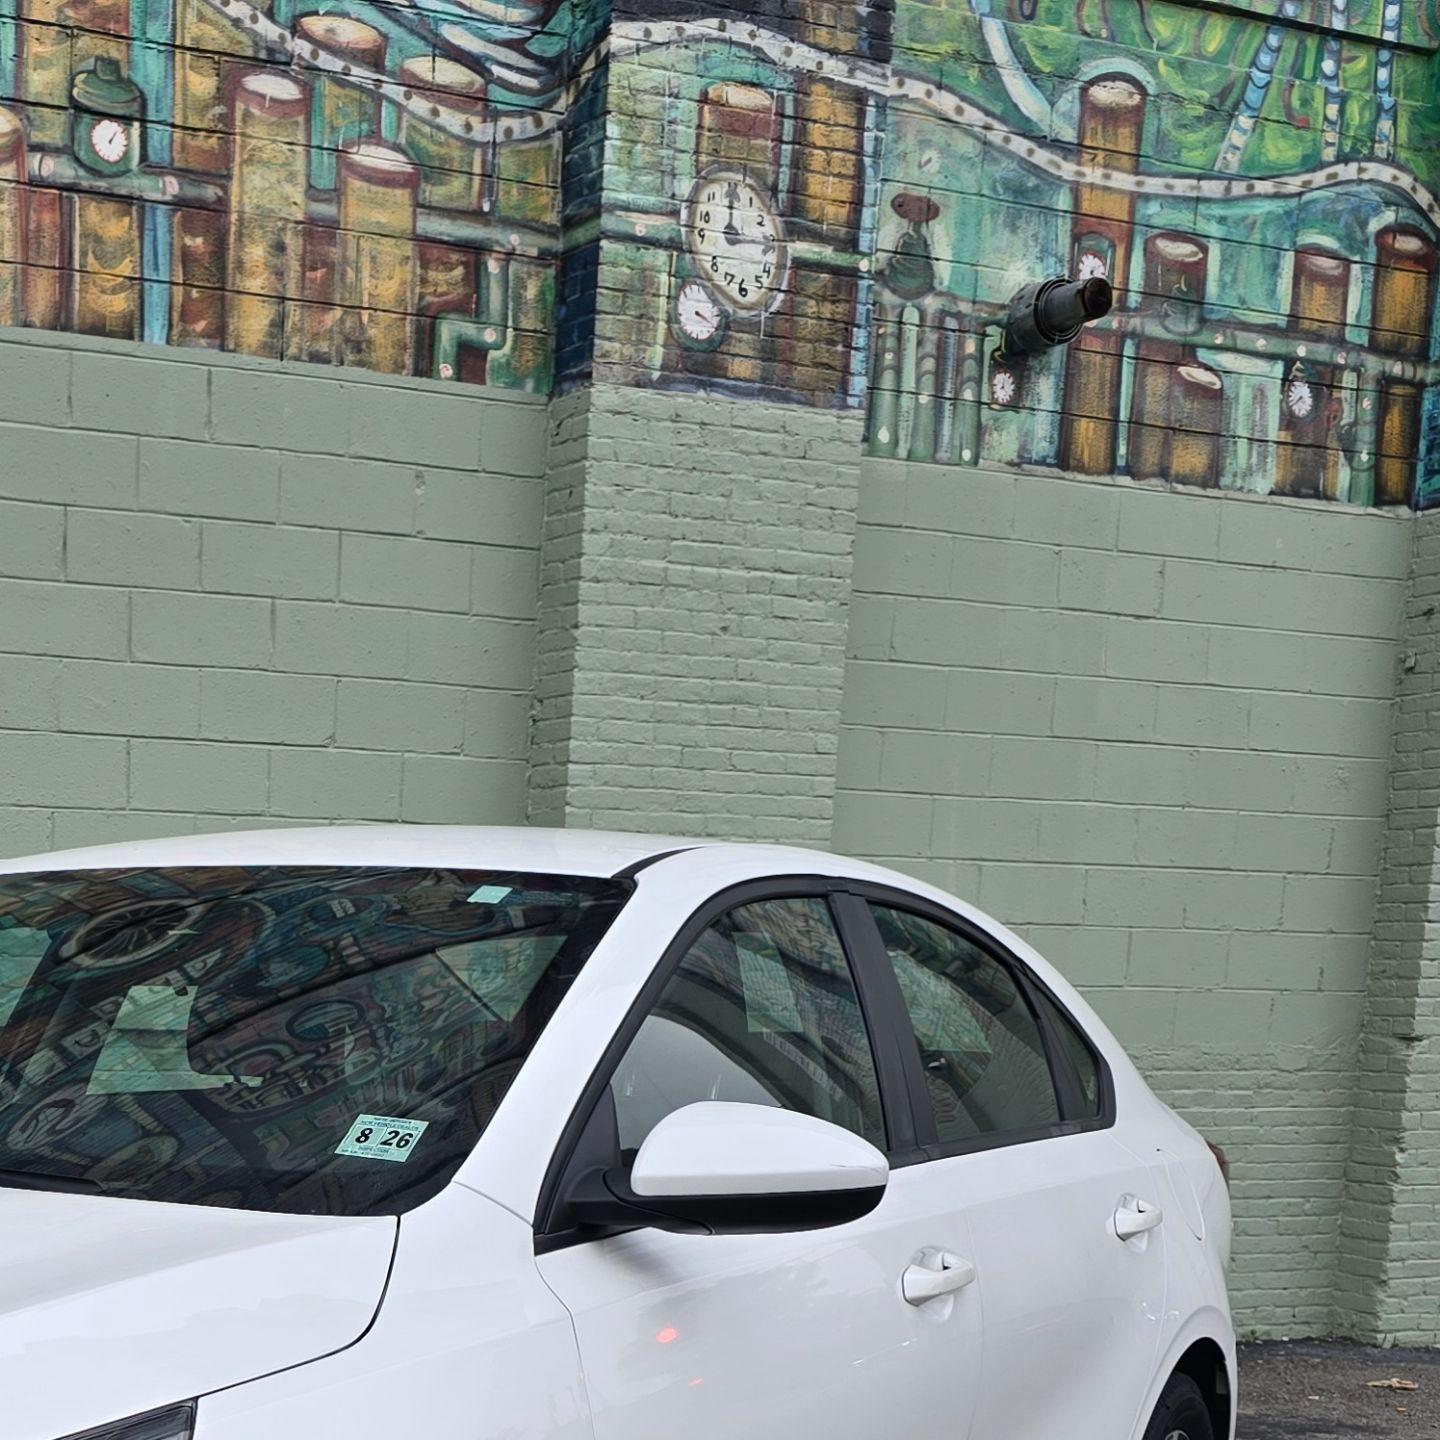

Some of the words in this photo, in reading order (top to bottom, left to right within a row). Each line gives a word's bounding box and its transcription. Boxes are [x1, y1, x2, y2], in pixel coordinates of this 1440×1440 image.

[708, 191, 715, 202] 11
[749, 196, 753, 208] 1
[699, 210, 710, 223] 10
[757, 214, 765, 227] 2
[698, 228, 705, 245] 9
[711, 255, 719, 272] 8
[763, 264, 771, 279] 4
[724, 272, 735, 286] 7
[755, 275, 764, 289] 5
[738, 278, 748, 298] 6
[355, 1128, 373, 1143] 8
[380, 1130, 414, 1148] 26
